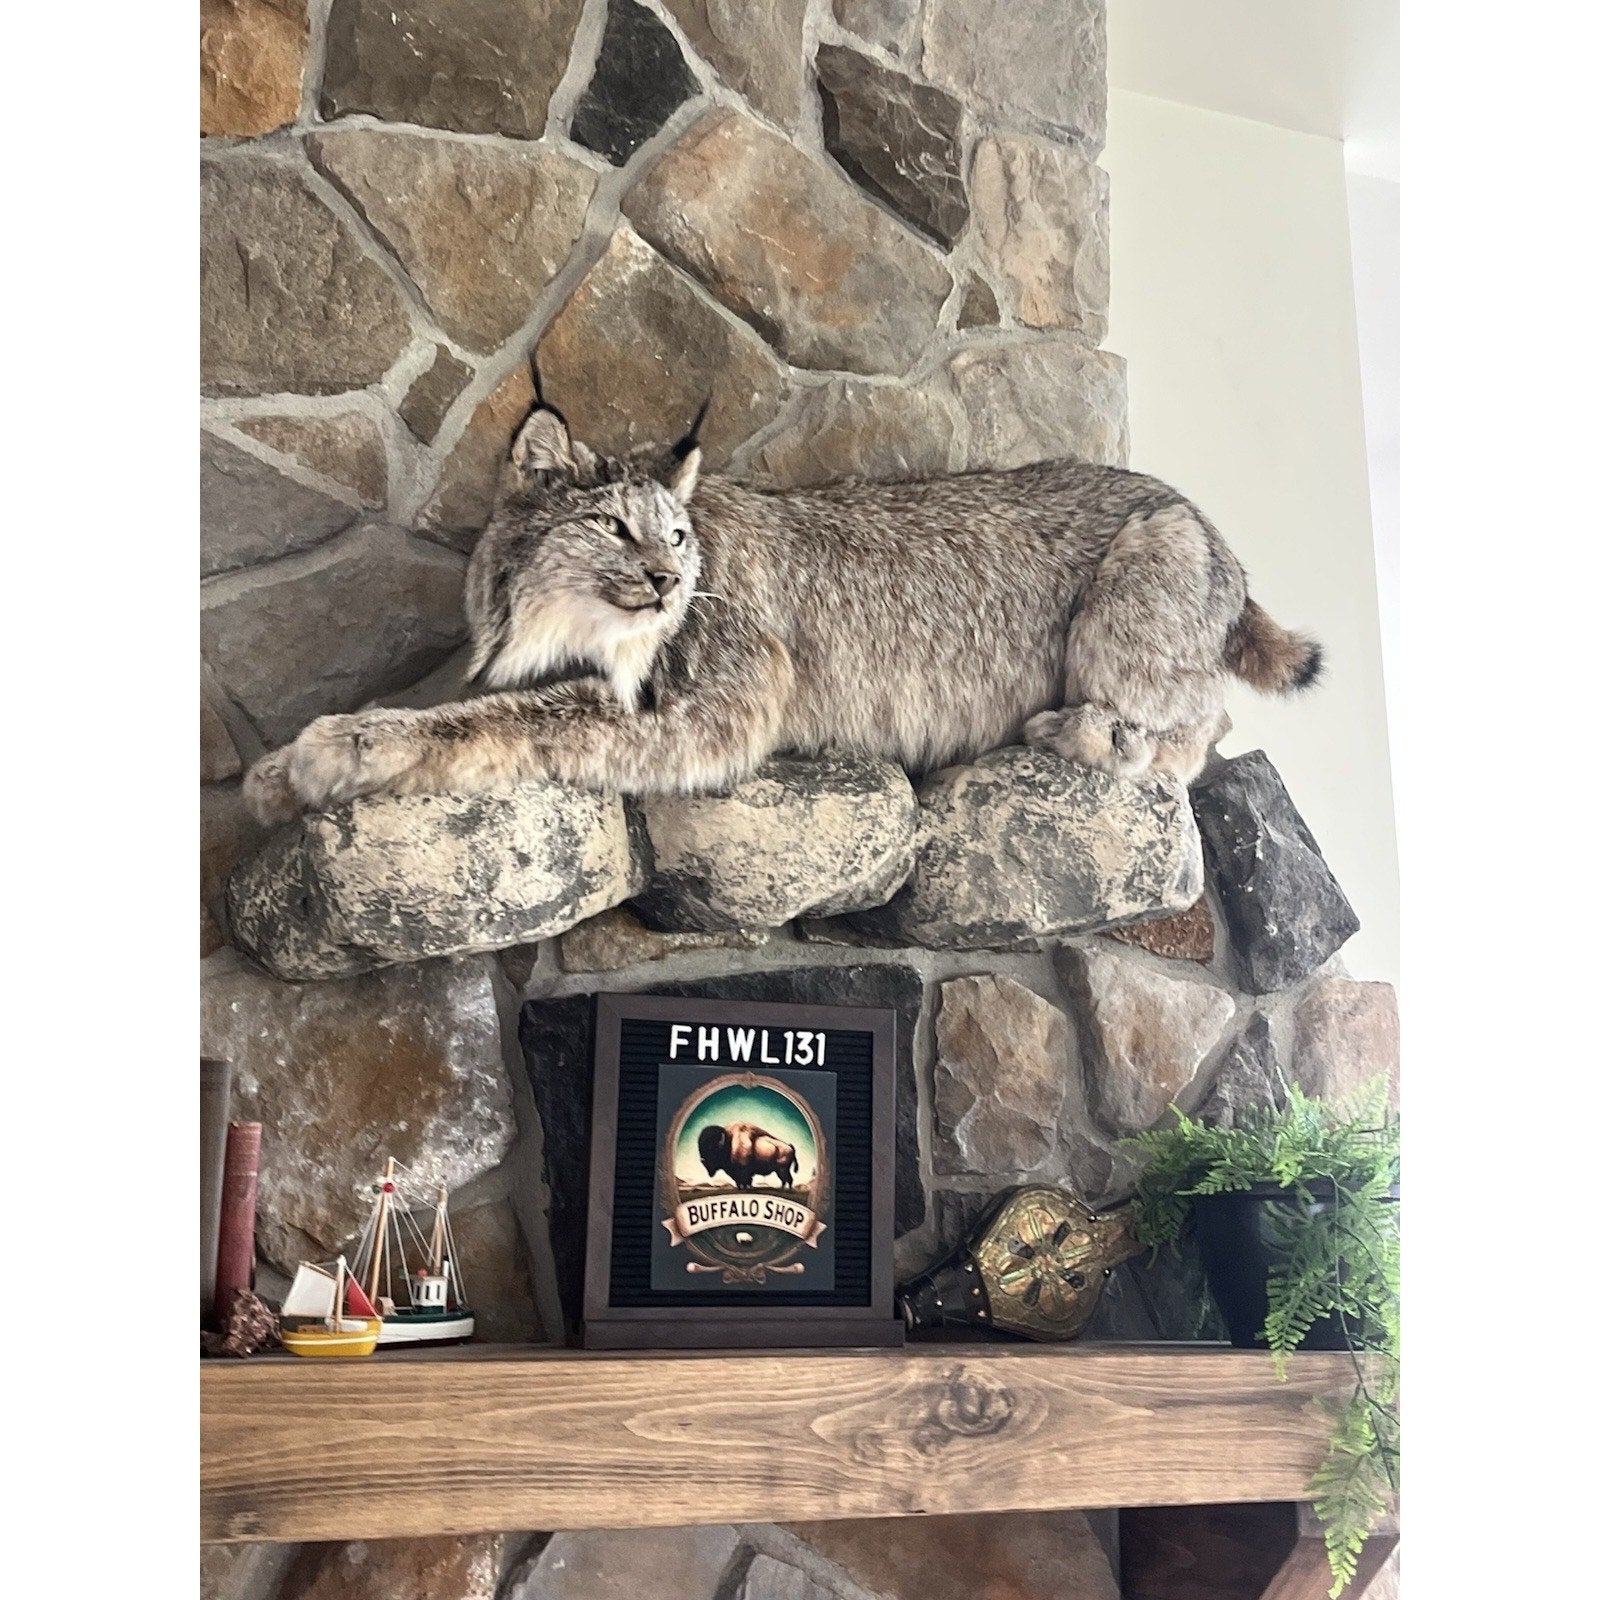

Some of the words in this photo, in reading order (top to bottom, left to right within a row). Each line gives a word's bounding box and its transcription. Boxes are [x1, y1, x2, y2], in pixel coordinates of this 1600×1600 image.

[669, 1024, 826, 1066] FHWL131
[687, 1199, 760, 1226] BUFFALO
[764, 1200, 805, 1228] SHOP
